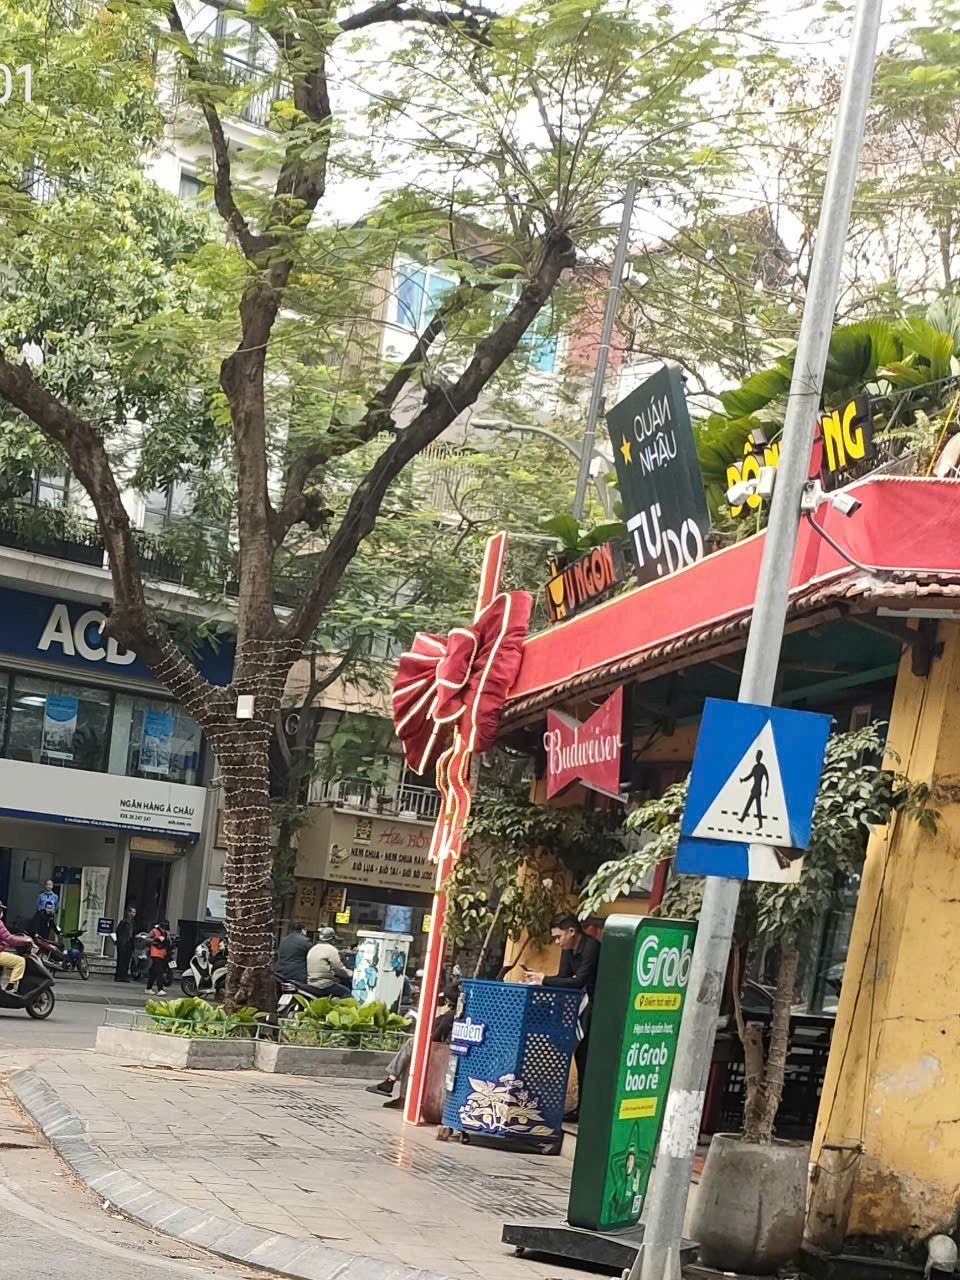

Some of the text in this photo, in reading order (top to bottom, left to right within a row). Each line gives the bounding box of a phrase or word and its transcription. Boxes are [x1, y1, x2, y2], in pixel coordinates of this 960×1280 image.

[633, 395, 672, 442] QUÁN
[639, 430, 678, 477] NHẬU
[661, 517, 704, 575] DO
[574, 541, 616, 602] NGON
[543, 727, 623, 775] Budweiser
[119, 798, 142, 810] NGÂN
[143, 801, 165, 812] HÀNG
[173, 805, 195, 816] CHÂU
[637, 934, 692, 988] Grab
[626, 1041, 668, 1068] đi Grab
[625, 1066, 659, 1092] bao rẻ
